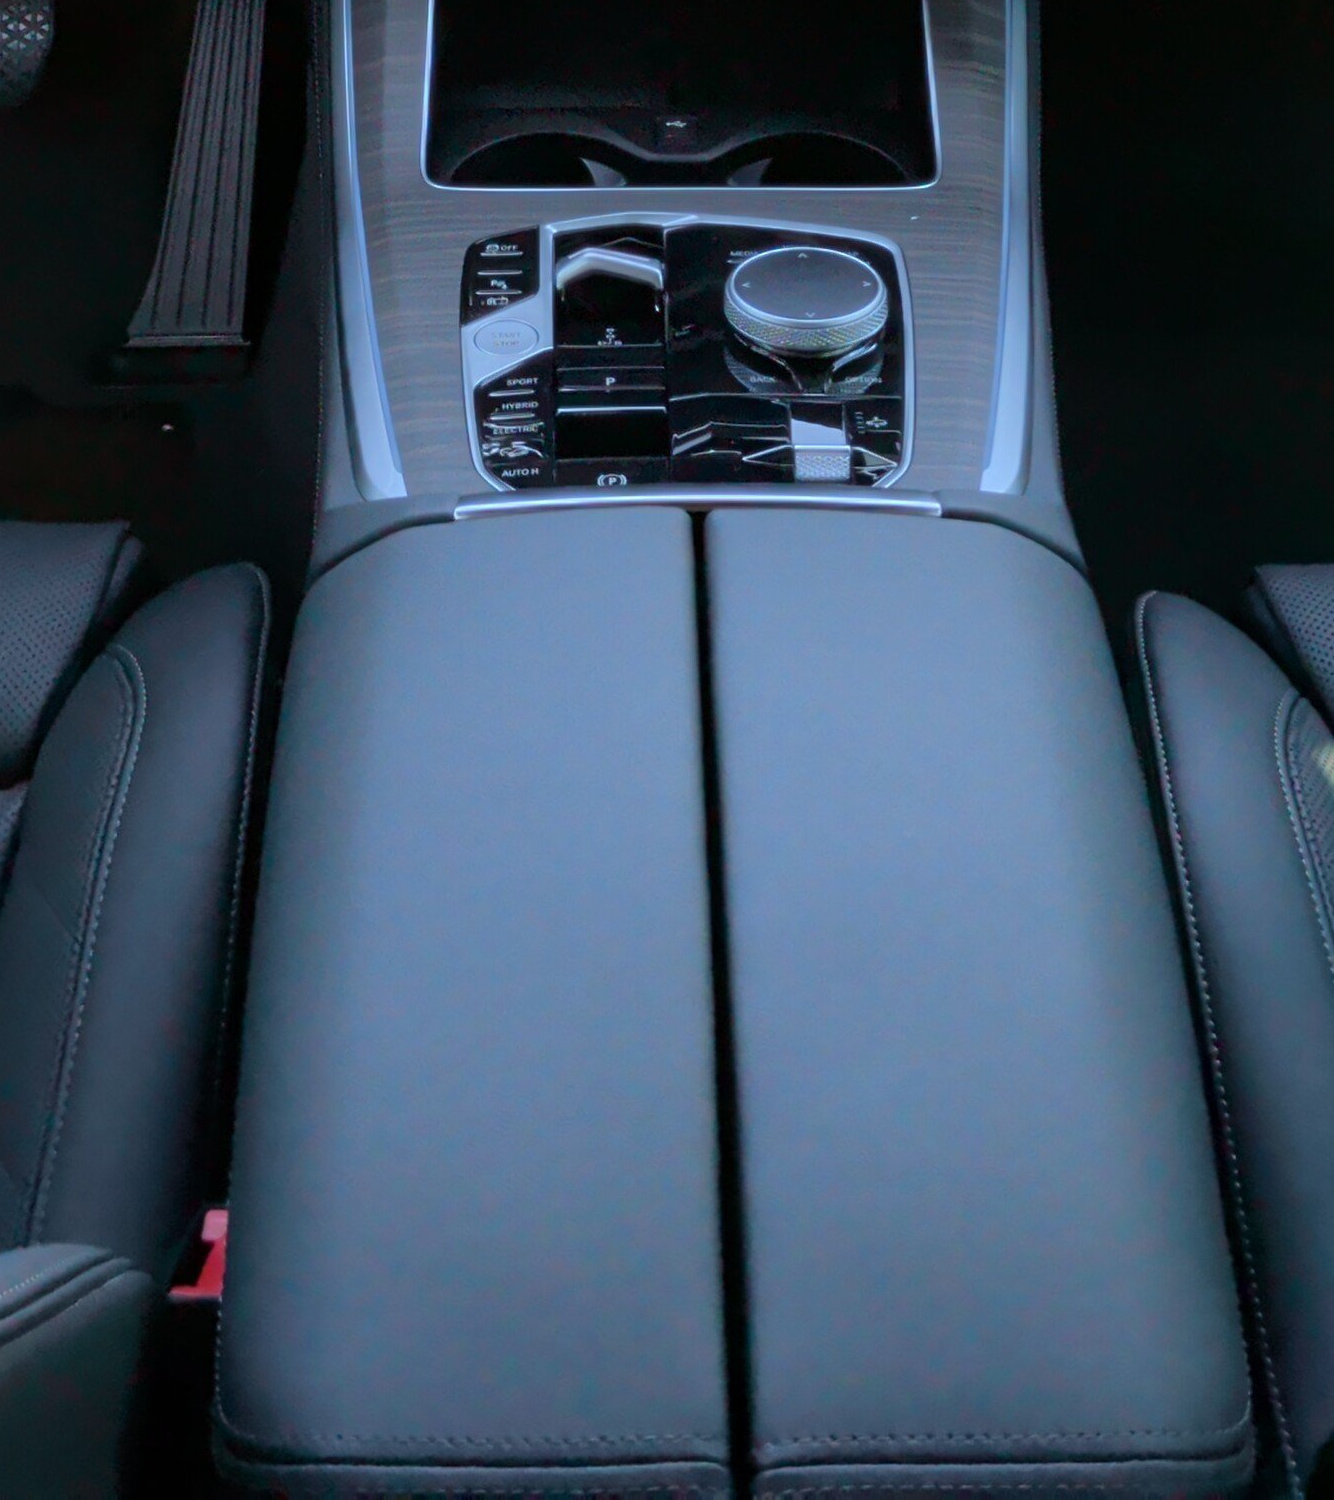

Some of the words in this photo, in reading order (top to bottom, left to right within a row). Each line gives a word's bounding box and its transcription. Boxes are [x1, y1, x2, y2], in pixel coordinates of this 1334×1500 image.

[507, 377, 539, 386] SPORT
[605, 377, 616, 386] P
[501, 401, 539, 410] HYBRID
[492, 424, 539, 435] ELECTRIC
[501, 467, 530, 477] AUTO
[530, 467, 539, 475] H
